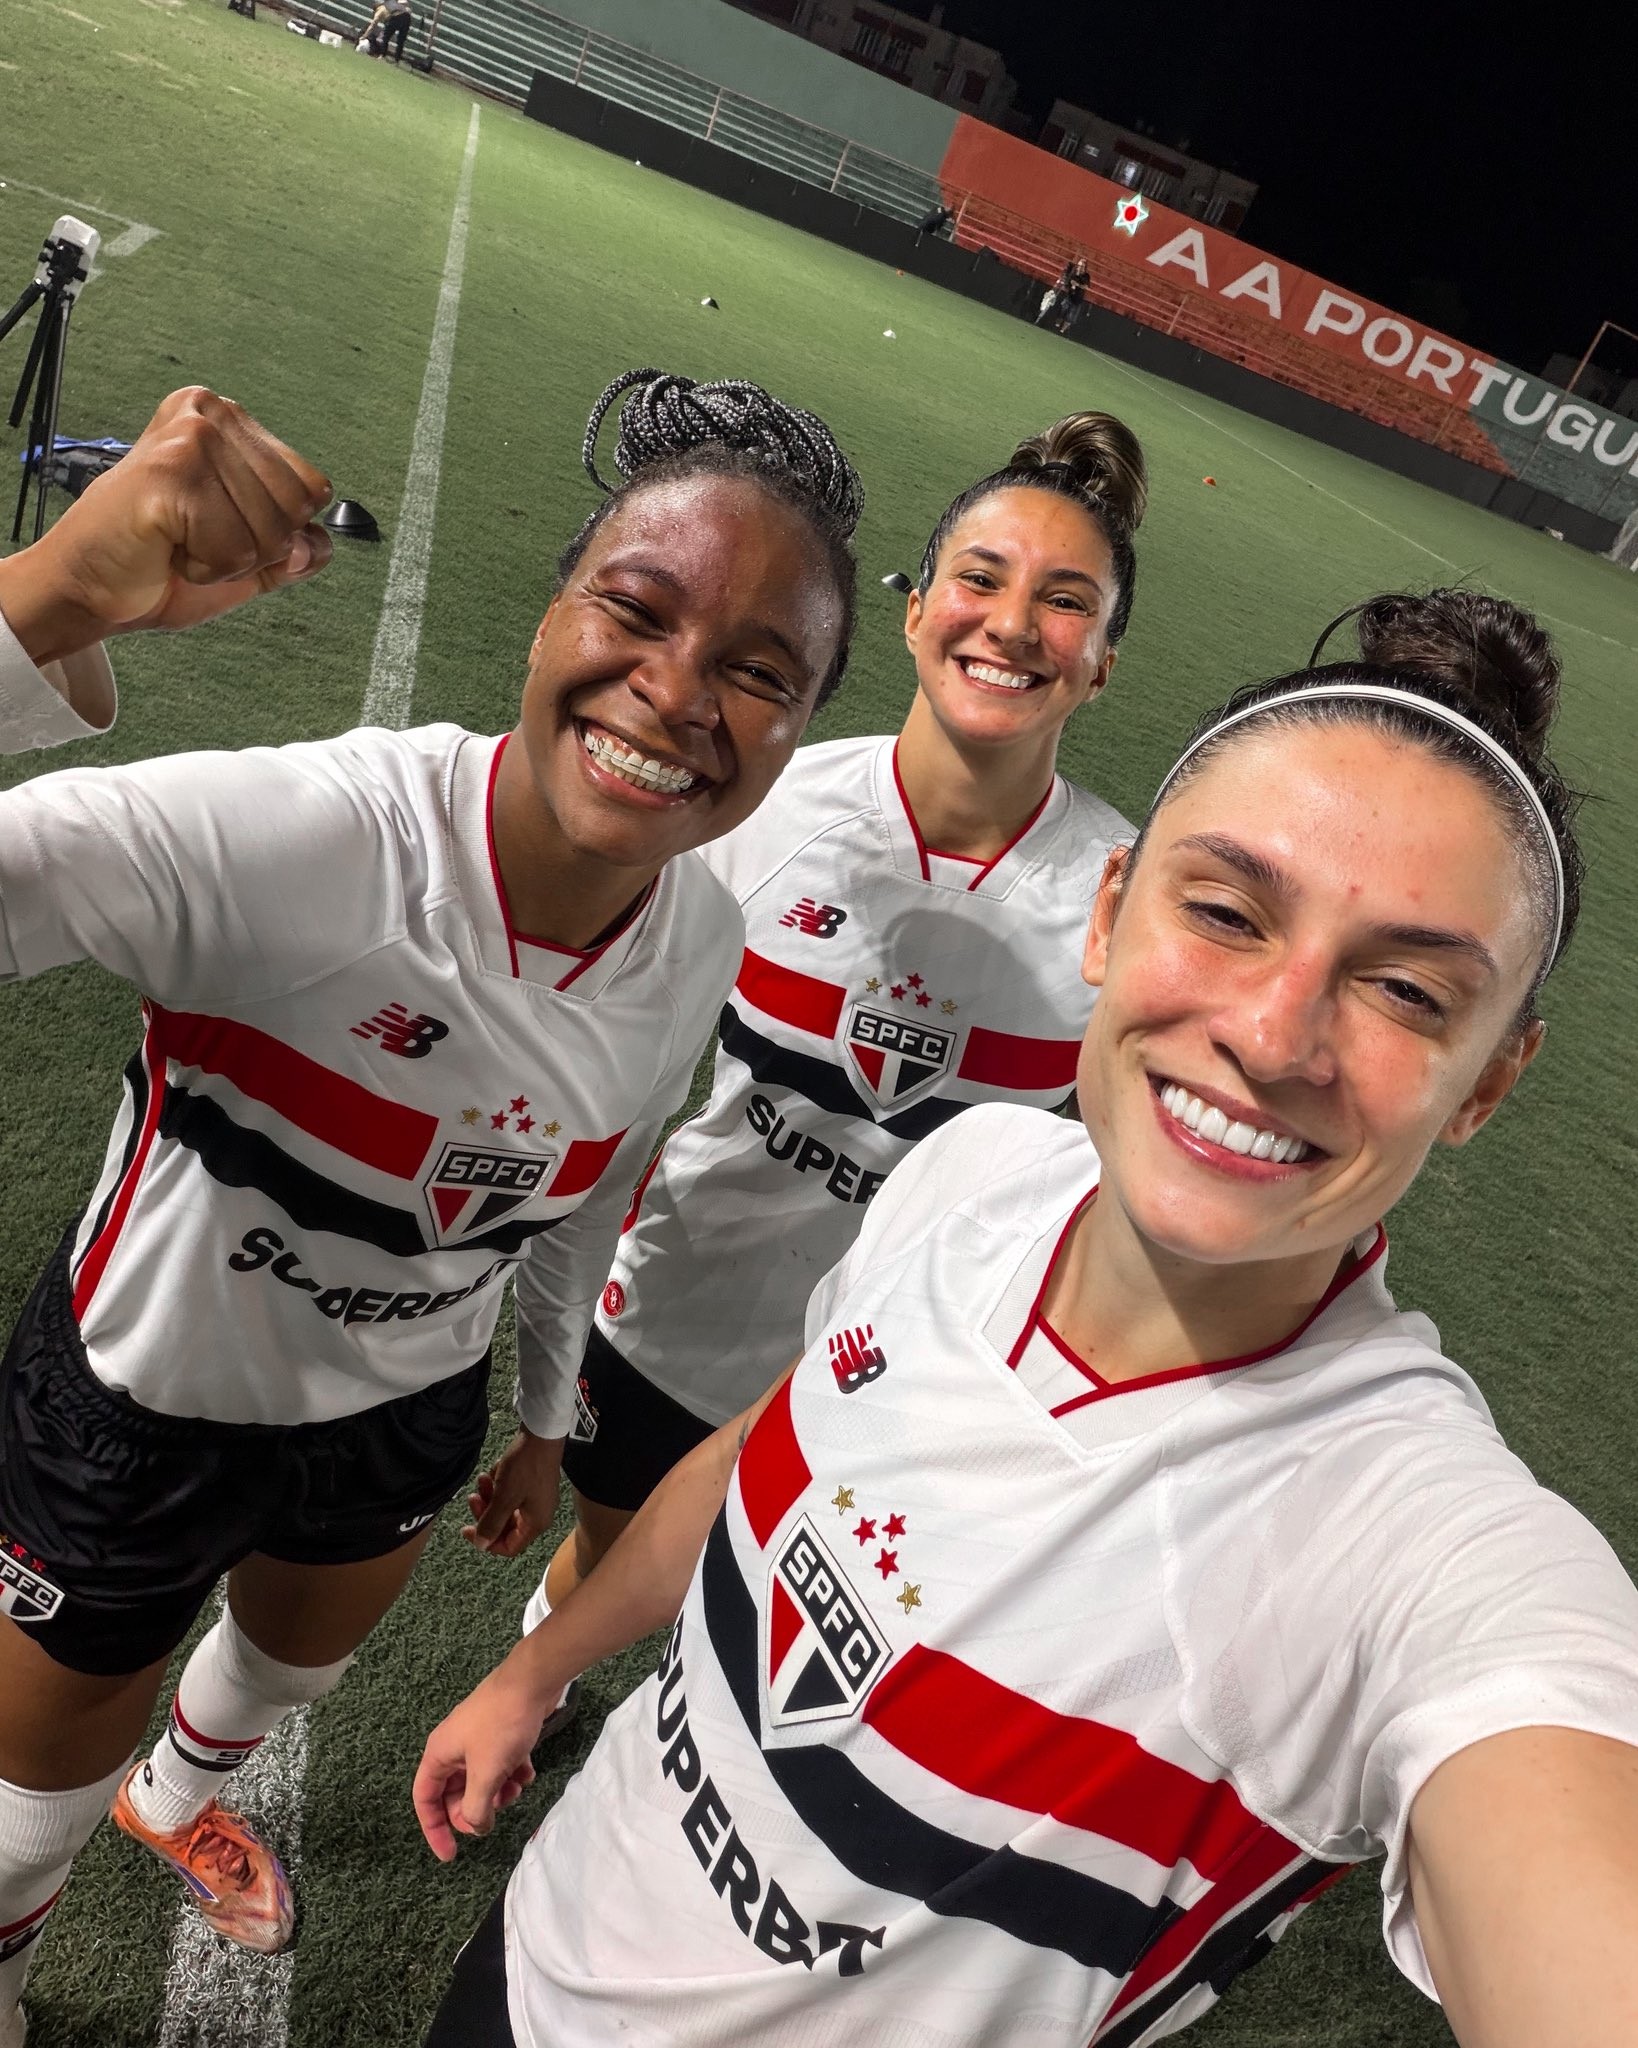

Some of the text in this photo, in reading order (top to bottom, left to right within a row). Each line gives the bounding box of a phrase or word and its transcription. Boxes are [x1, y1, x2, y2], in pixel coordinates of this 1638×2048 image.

[1146, 227, 1638, 477] A A PORTUGU
[856, 1016, 943, 1060] SPFC
[443, 1156, 541, 1187] SPFC
[0, 1558, 53, 1606] PFC
[786, 1540, 872, 1678] SPFC
